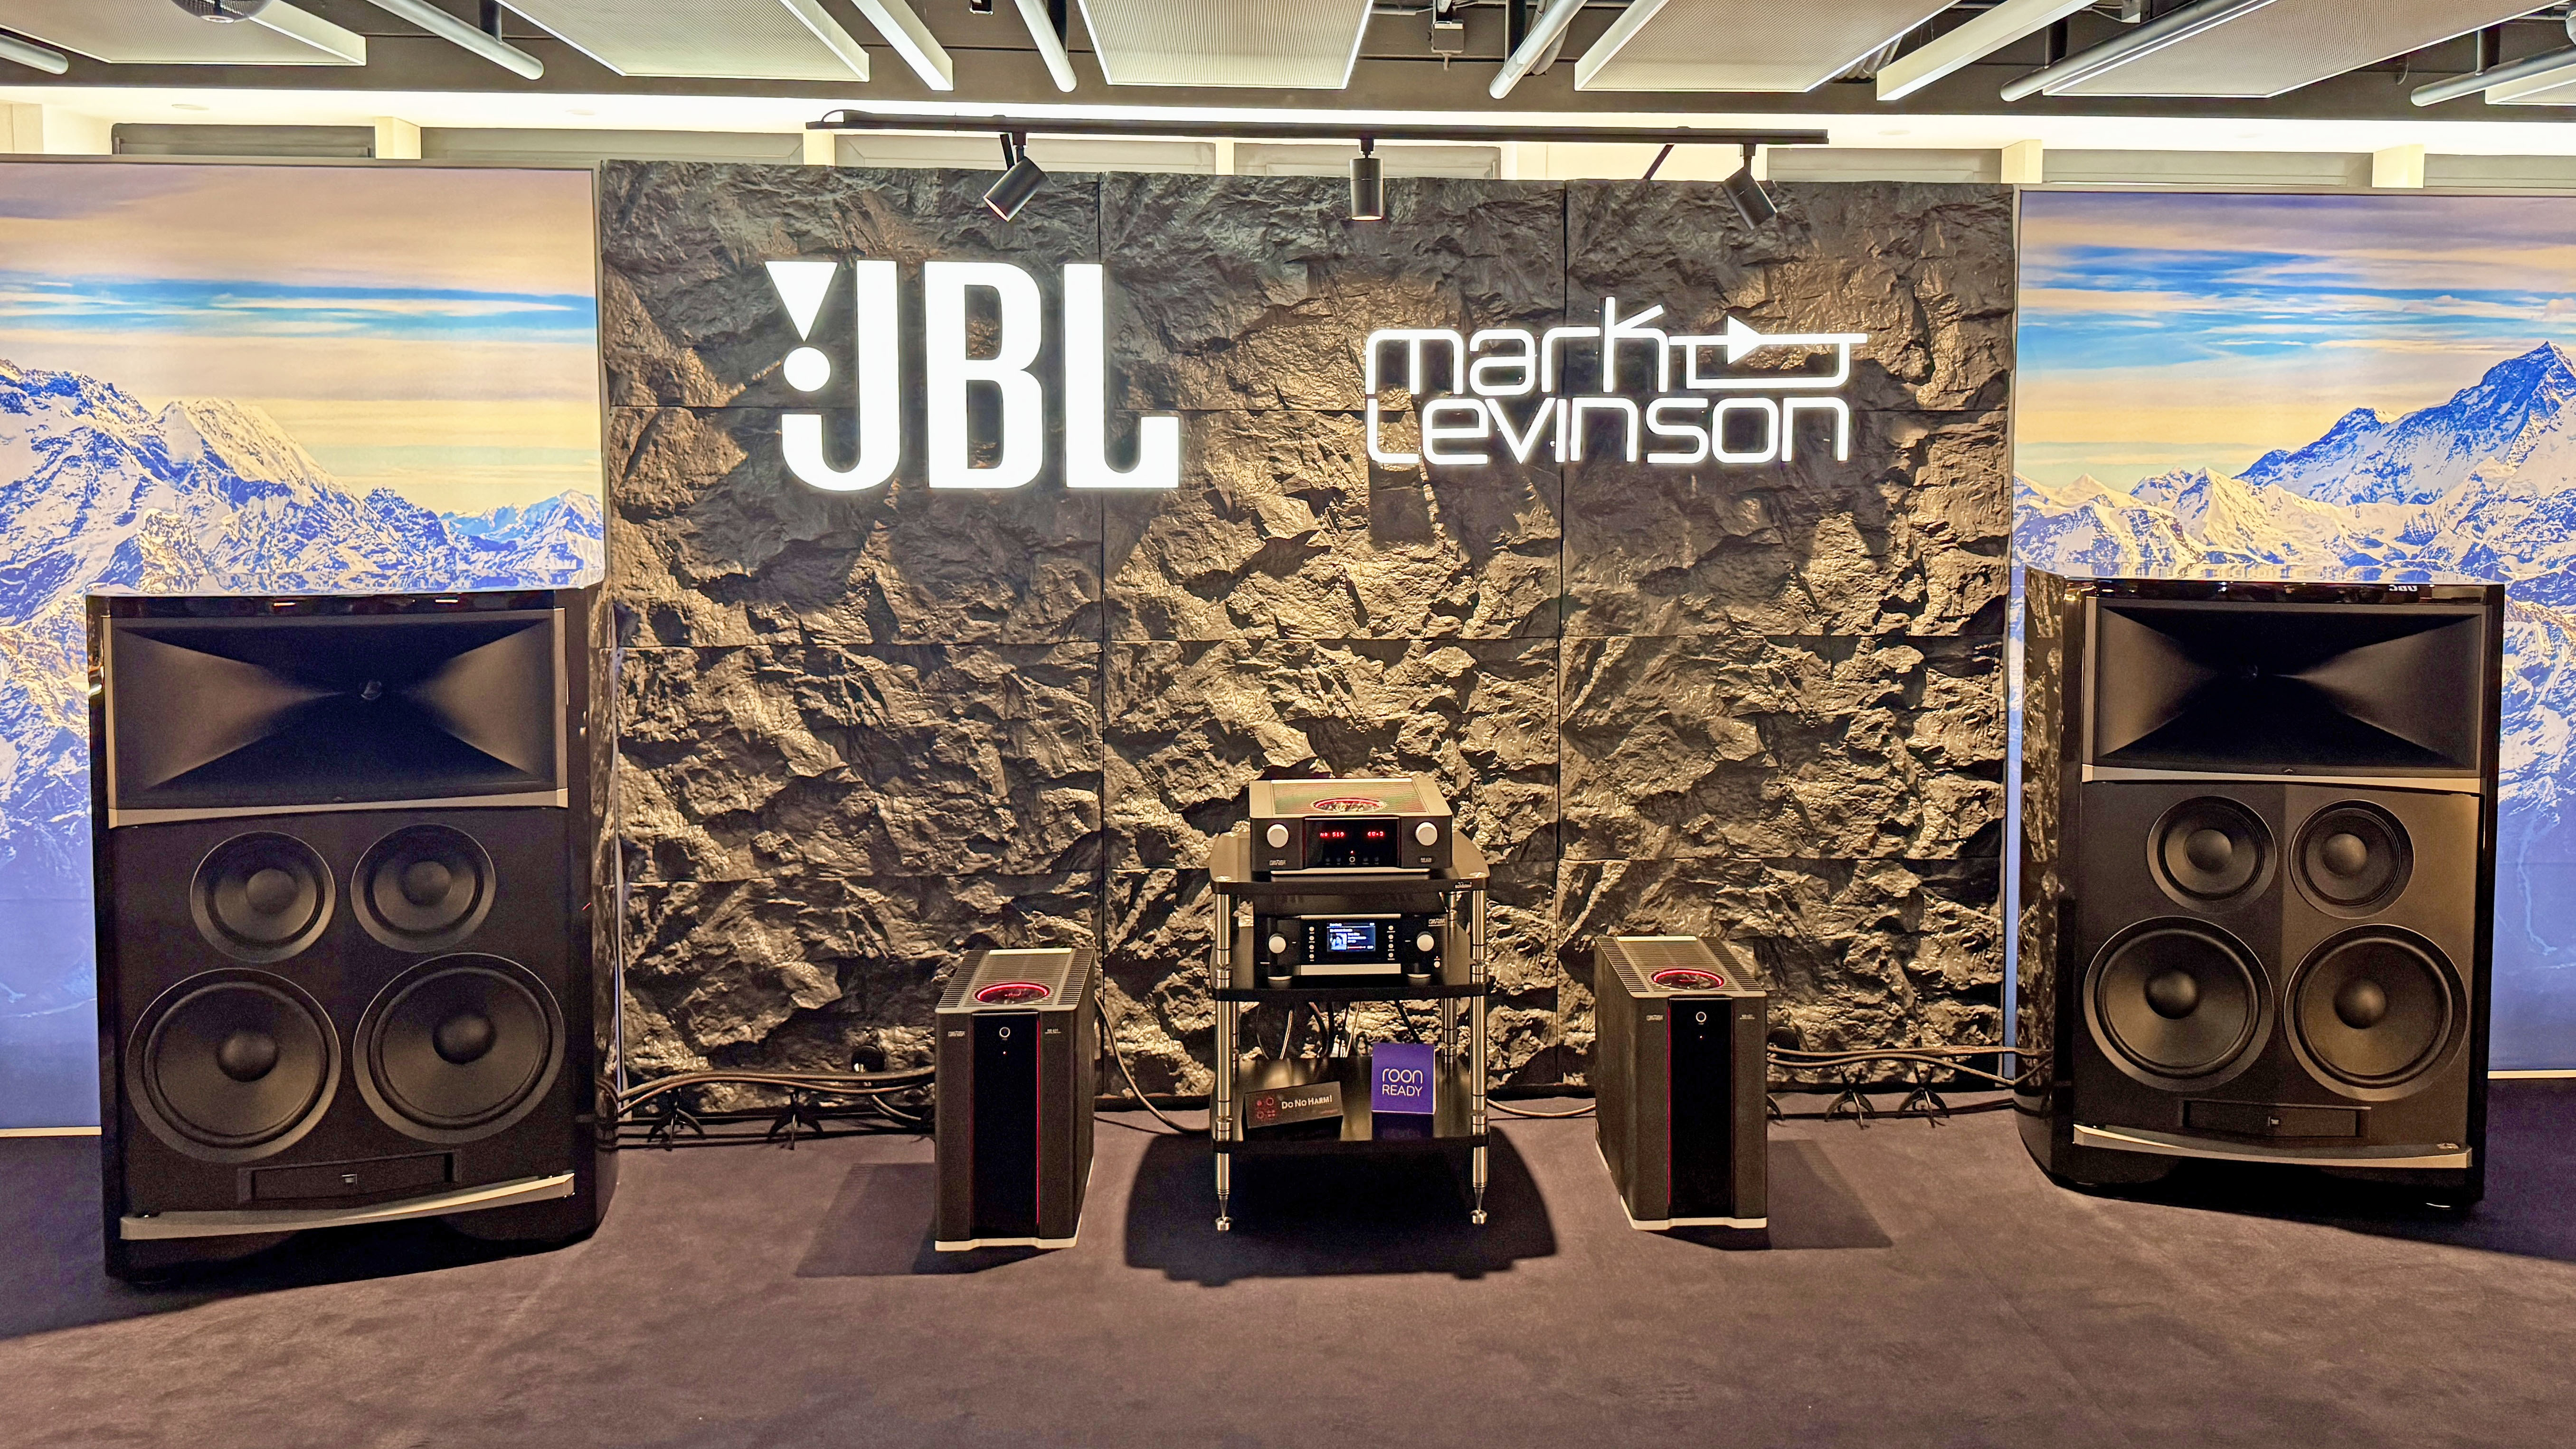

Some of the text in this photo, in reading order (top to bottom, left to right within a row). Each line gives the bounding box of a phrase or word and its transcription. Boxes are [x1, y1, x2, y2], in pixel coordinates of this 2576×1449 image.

[782, 260, 1179, 491] JBL
[1382, 1068, 1423, 1084] roon
[1382, 1084, 1423, 1097] READY
